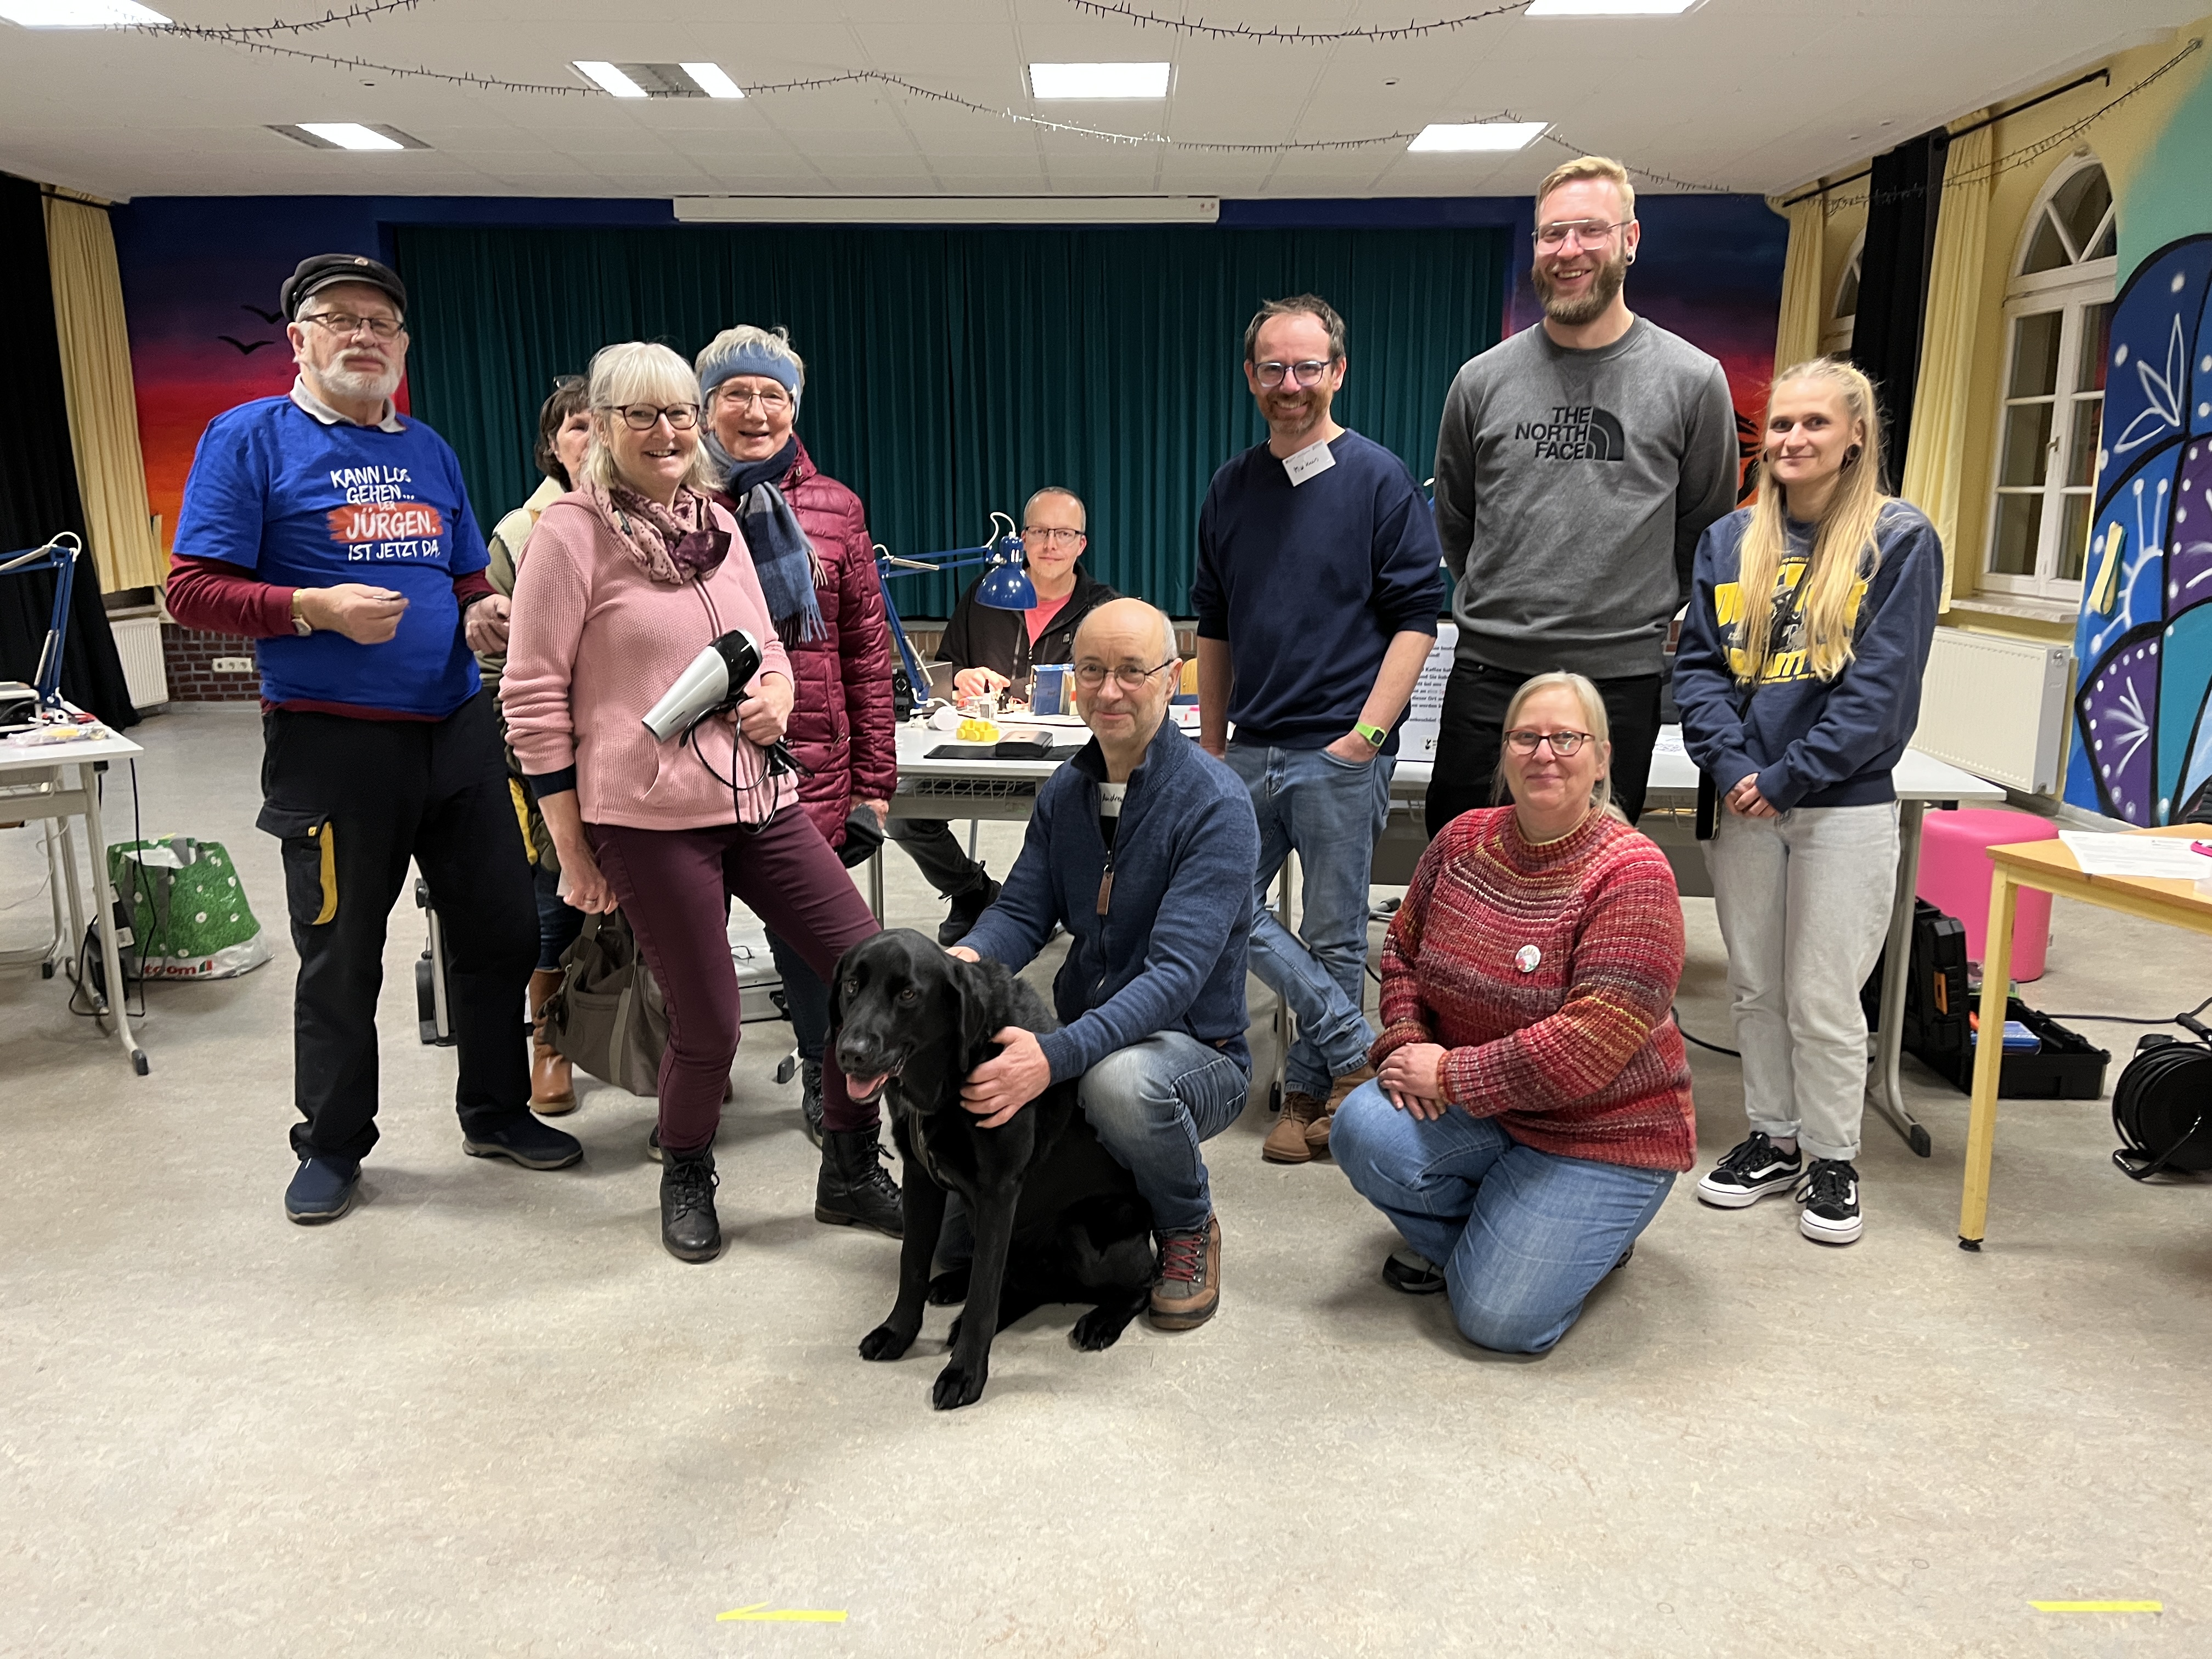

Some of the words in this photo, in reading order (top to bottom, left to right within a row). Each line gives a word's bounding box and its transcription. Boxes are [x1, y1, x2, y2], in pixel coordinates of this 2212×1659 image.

[1553, 406, 1592, 424] THE
[1515, 422, 1589, 442] NORTH
[1534, 441, 1586, 460] FACE
[330, 466, 380, 488] KANN
[346, 507, 437, 541] JÜRGEN.
[348, 544, 373, 561] IST
[376, 540, 419, 558] JETZT
